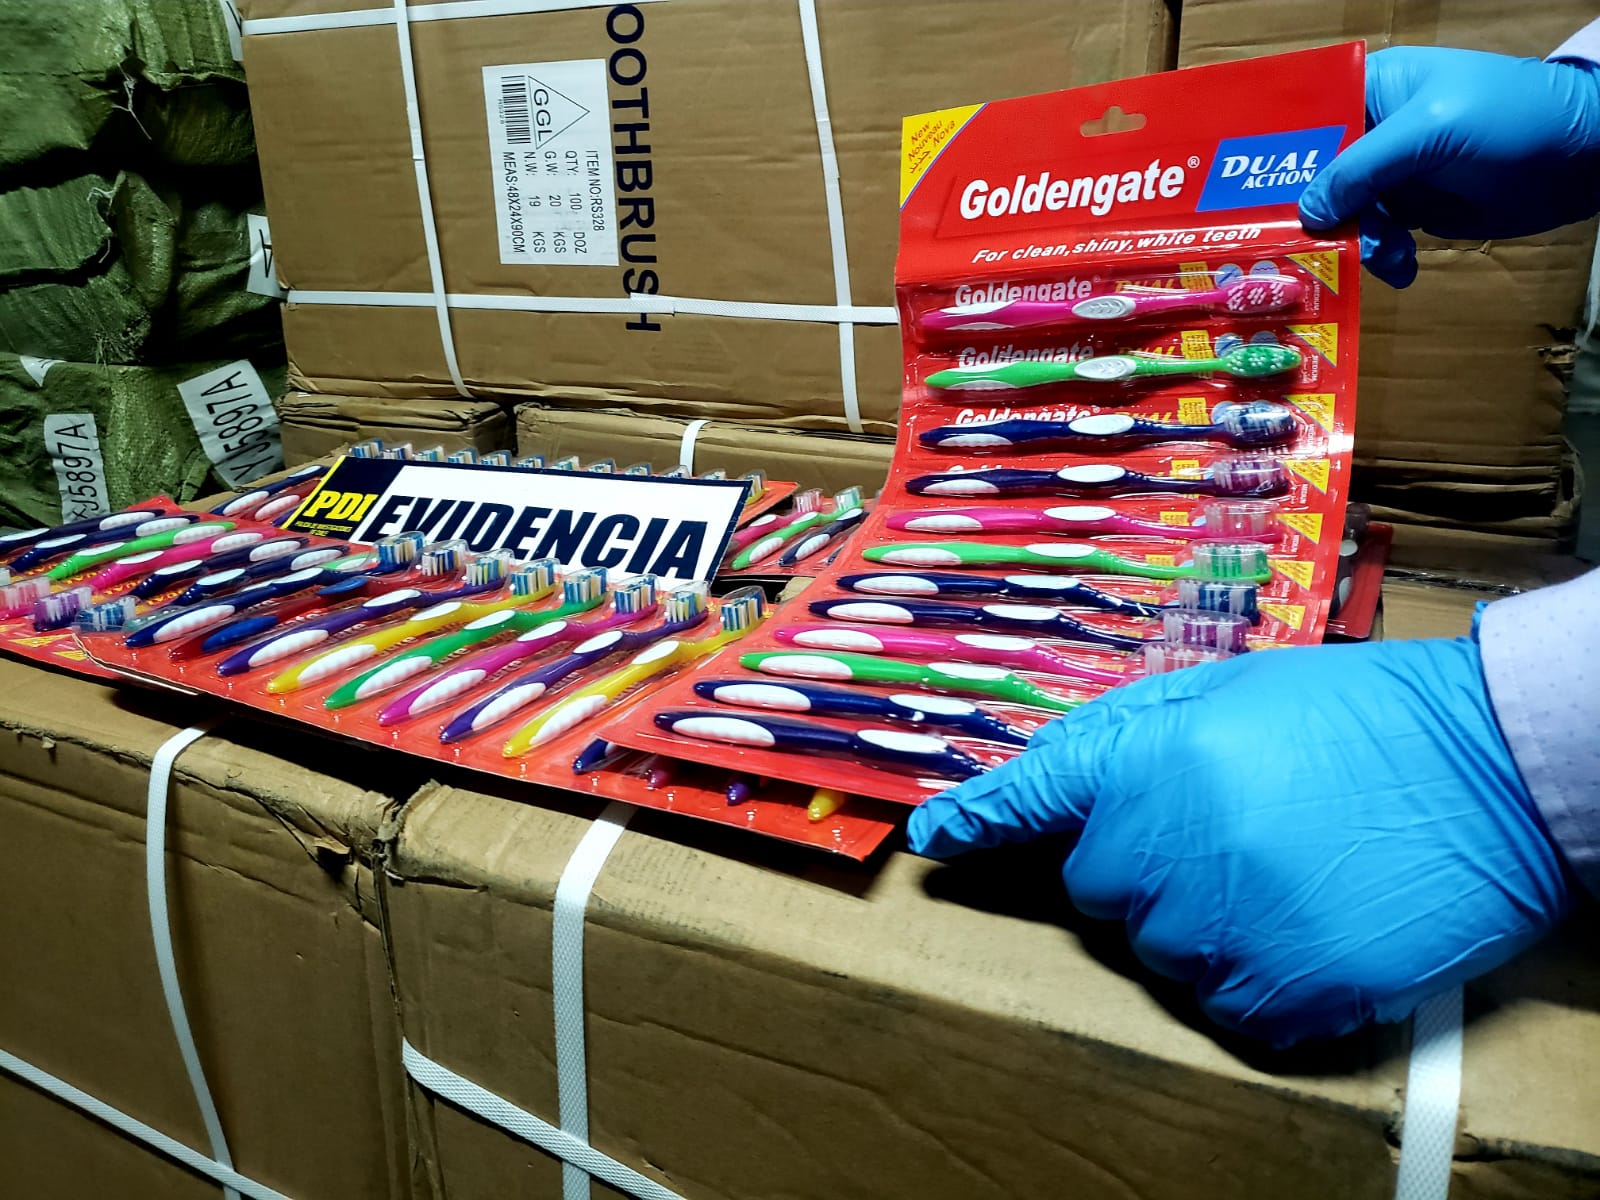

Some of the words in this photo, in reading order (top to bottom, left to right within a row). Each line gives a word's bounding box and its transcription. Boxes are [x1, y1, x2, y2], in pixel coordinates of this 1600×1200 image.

[533, 88, 553, 142] GGL
[908, 121, 943, 161] Nouveau
[911, 121, 930, 145] New
[933, 121, 955, 146] Nova
[523, 151, 538, 175] N.W:
[544, 151, 559, 175] G.W:
[565, 150, 579, 175] QTY:
[586, 150, 600, 176] ITEM
[1221, 150, 1320, 178] DUAL
[1241, 169, 1316, 190] ACTION
[502, 152, 526, 253] MEAS:48X24X90CM
[528, 195, 542, 207] 19
[549, 195, 562, 207] 20
[569, 193, 582, 210] 100
[588, 179, 605, 231] NO:RS328
[532, 232, 546, 253] KGS
[553, 232, 567, 253] KGS
[573, 232, 587, 254] DOZ
[972, 250, 1009, 264] For
[1203, 228, 1261, 243] teeth
[201, 371, 275, 481] YJ5897A
[302, 490, 379, 522] PDI
[358, 495, 708, 580] EVIDENCIA
